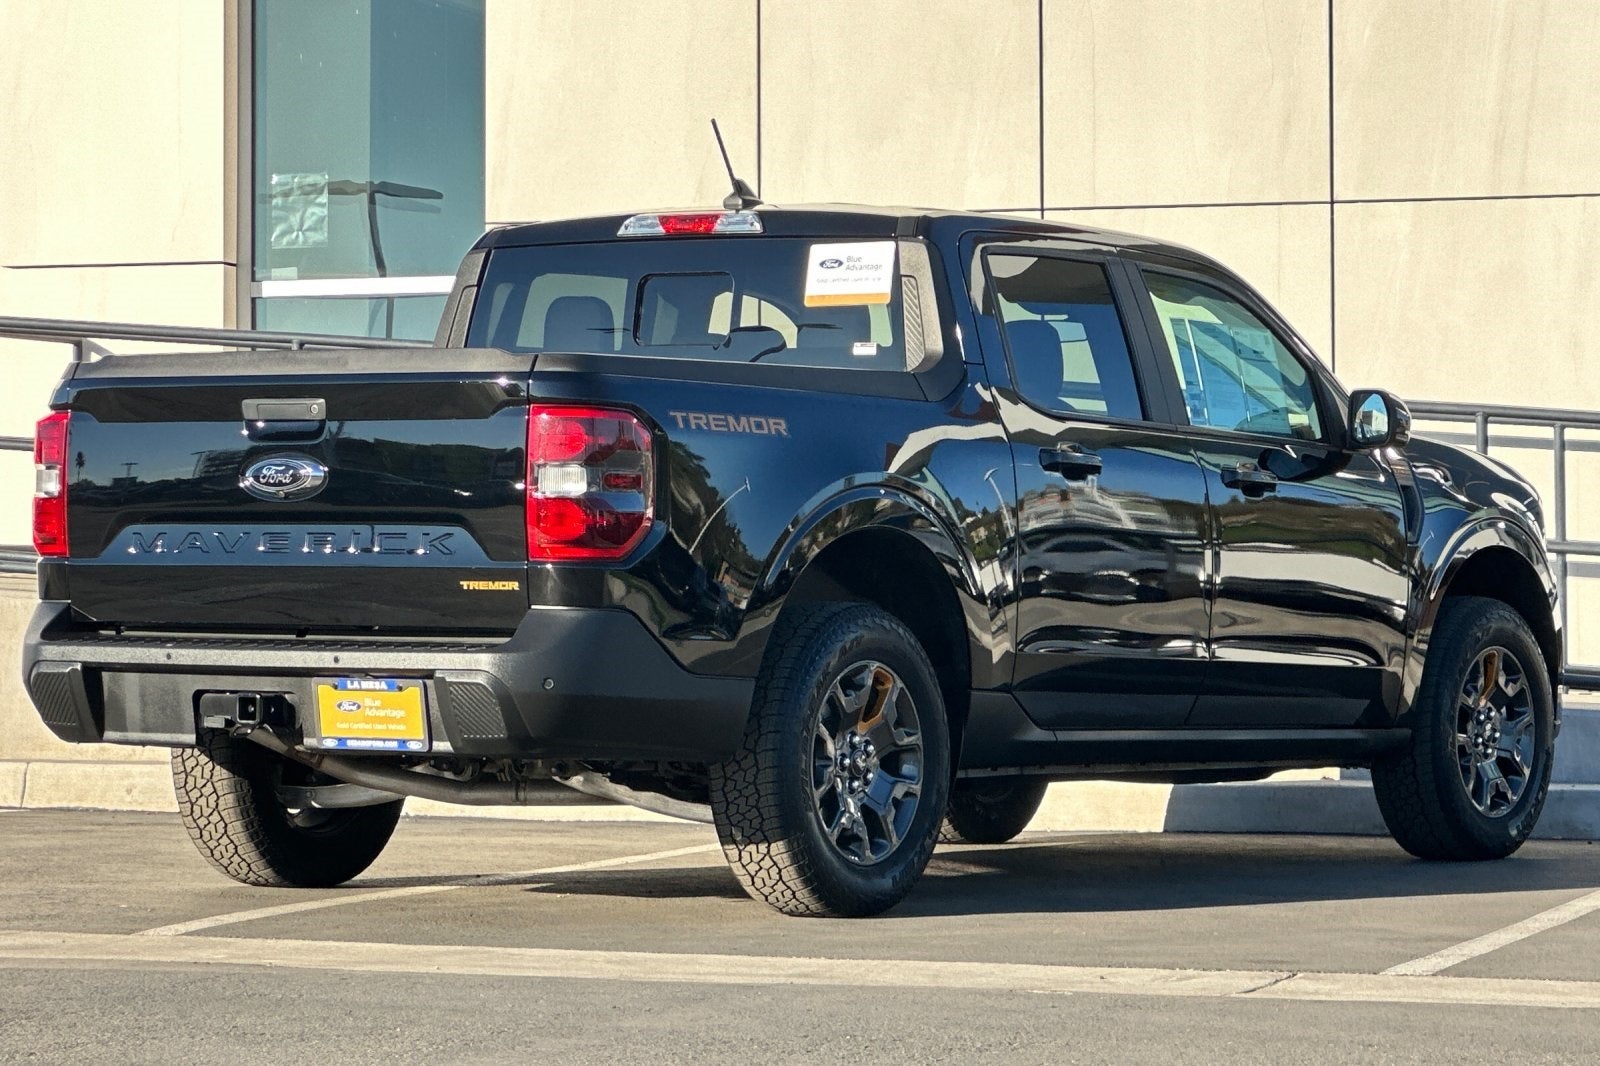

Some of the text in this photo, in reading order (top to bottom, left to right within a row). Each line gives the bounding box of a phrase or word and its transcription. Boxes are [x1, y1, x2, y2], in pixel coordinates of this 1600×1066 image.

[846, 255, 862, 263] Blue
[845, 263, 883, 272] Advantage
[669, 411, 788, 436] TREMOR
[259, 465, 294, 484] Ford
[128, 530, 457, 556] MAVERICK
[459, 580, 520, 591] TREMOR
[364, 697, 382, 707] Blue
[364, 708, 406, 719] Advantage
